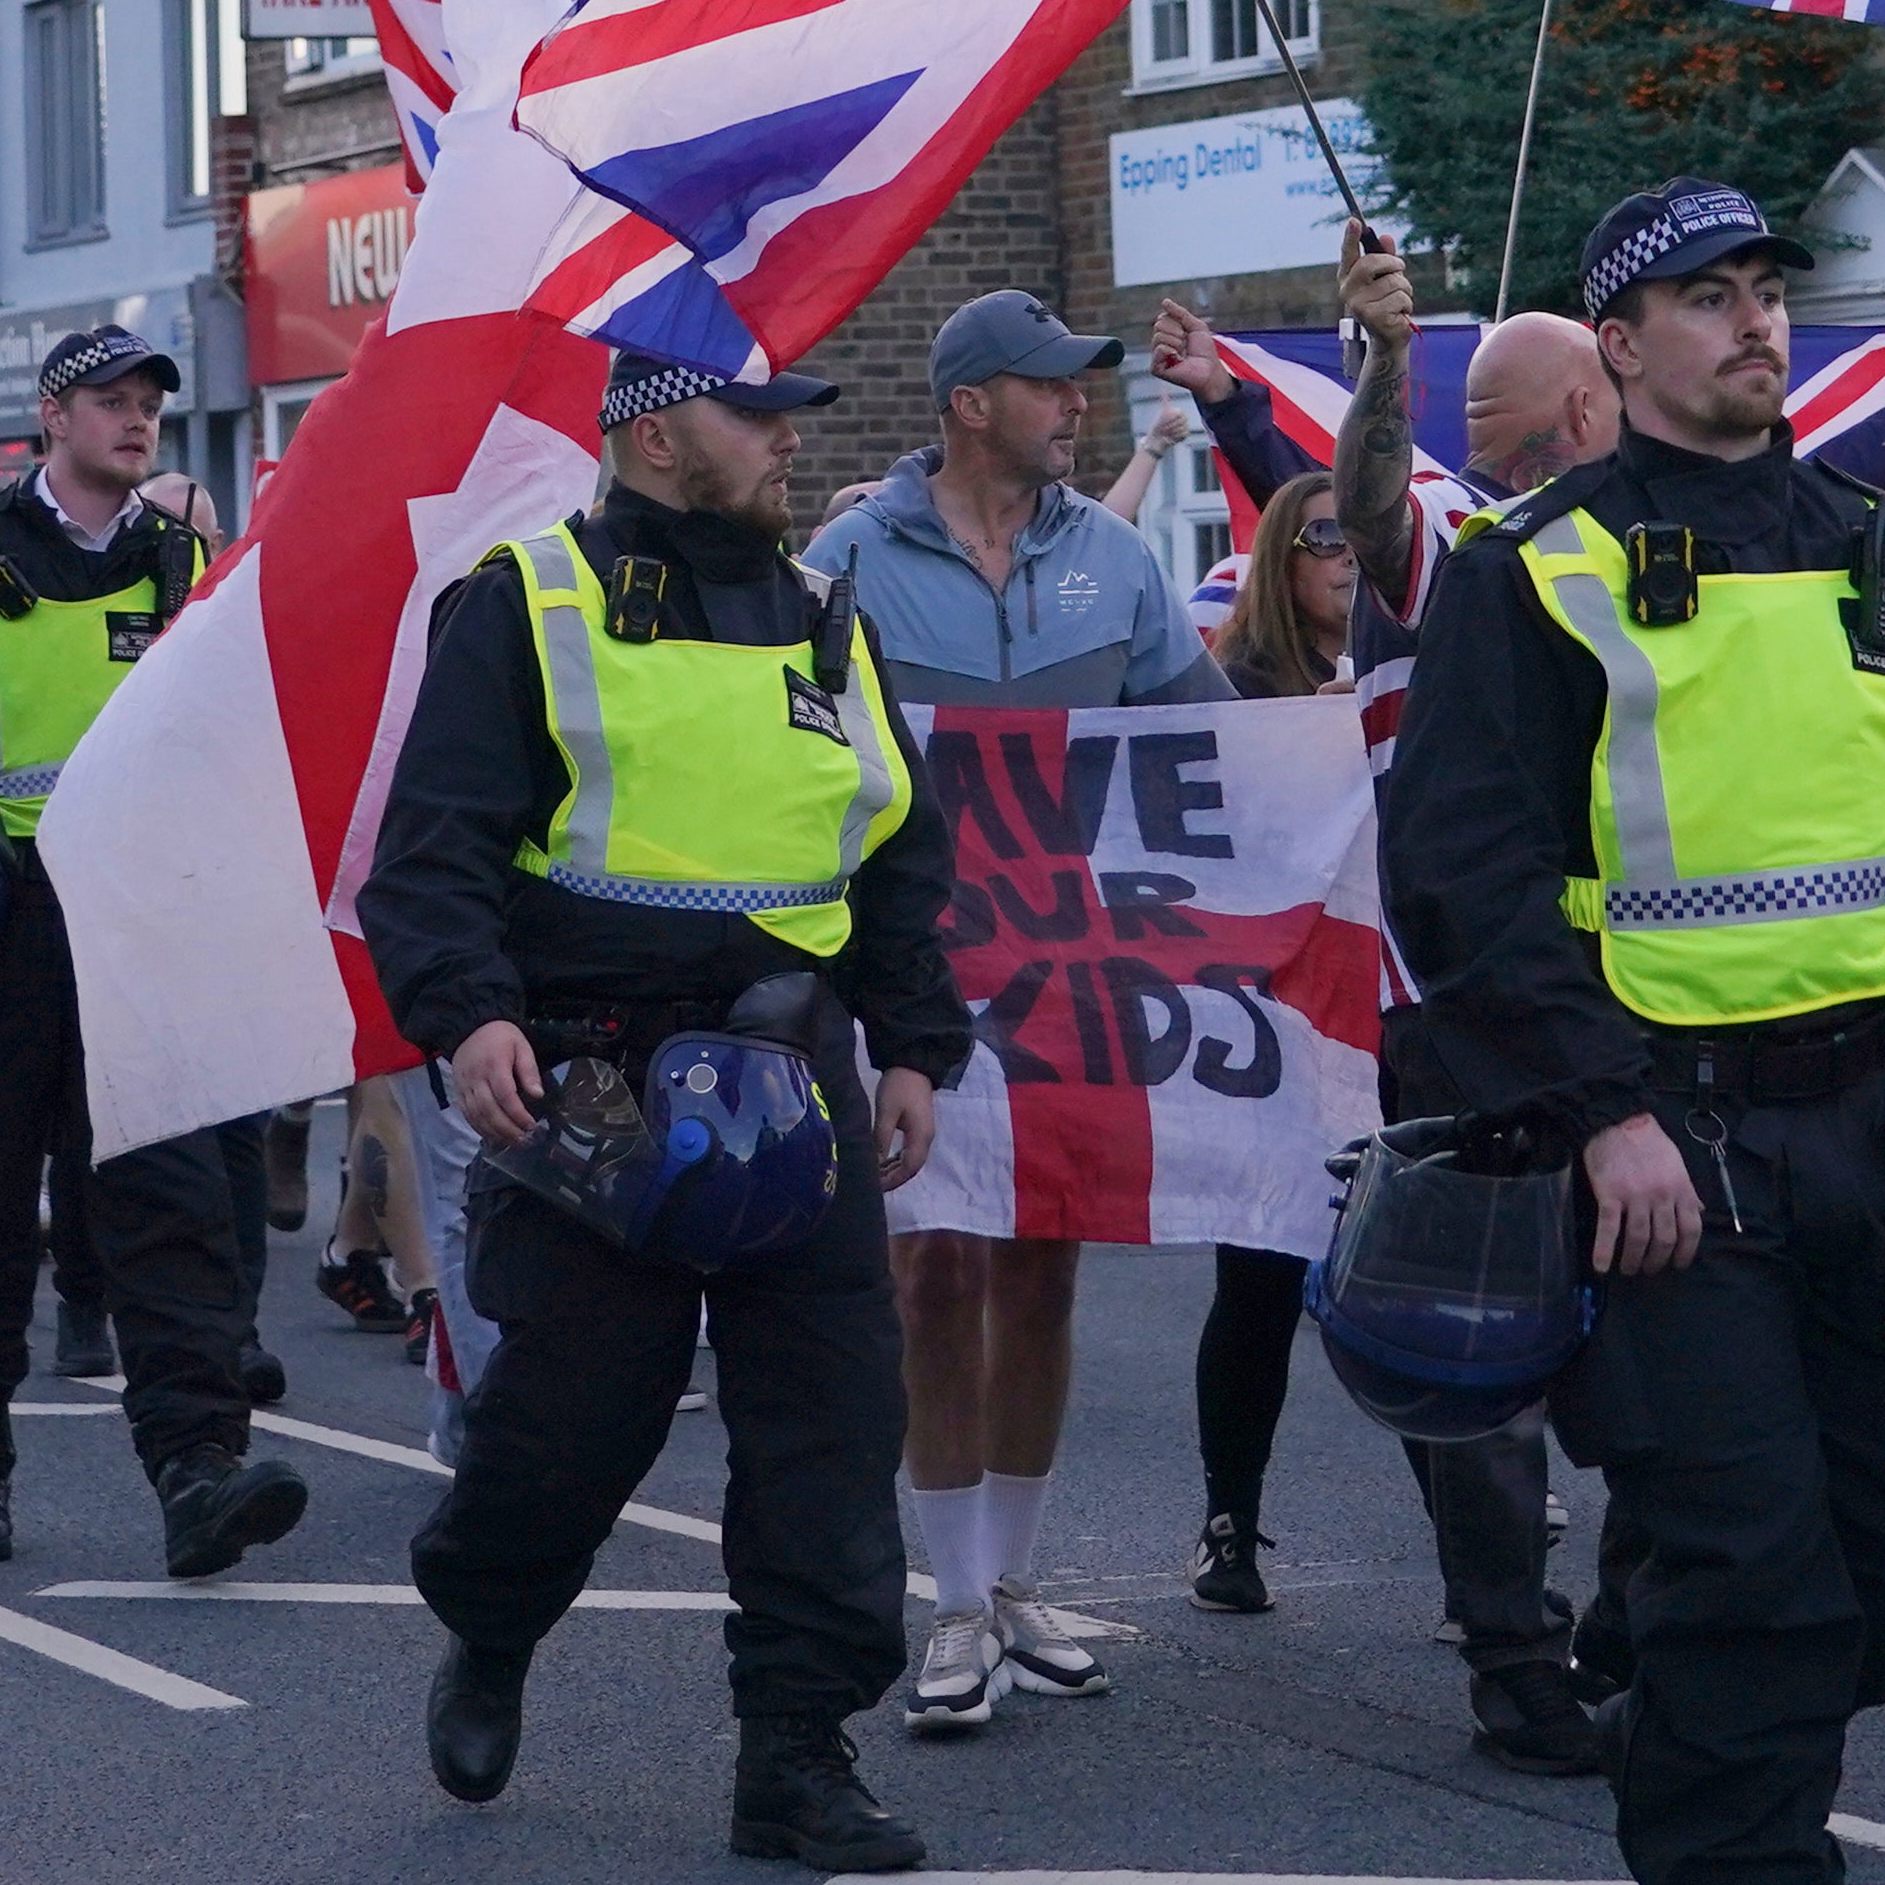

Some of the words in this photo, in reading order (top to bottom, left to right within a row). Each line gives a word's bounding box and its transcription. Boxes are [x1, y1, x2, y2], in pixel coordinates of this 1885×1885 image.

[1120, 149, 1187, 196] Epping
[1196, 134, 1261, 177] Dental
[326, 206, 408, 307] NEW
[1681, 214, 1719, 234] POLICE
[1718, 212, 1757, 227] OFFICER
[936, 869, 1209, 944] OUR
[944, 956, 1284, 1098] KIDS
